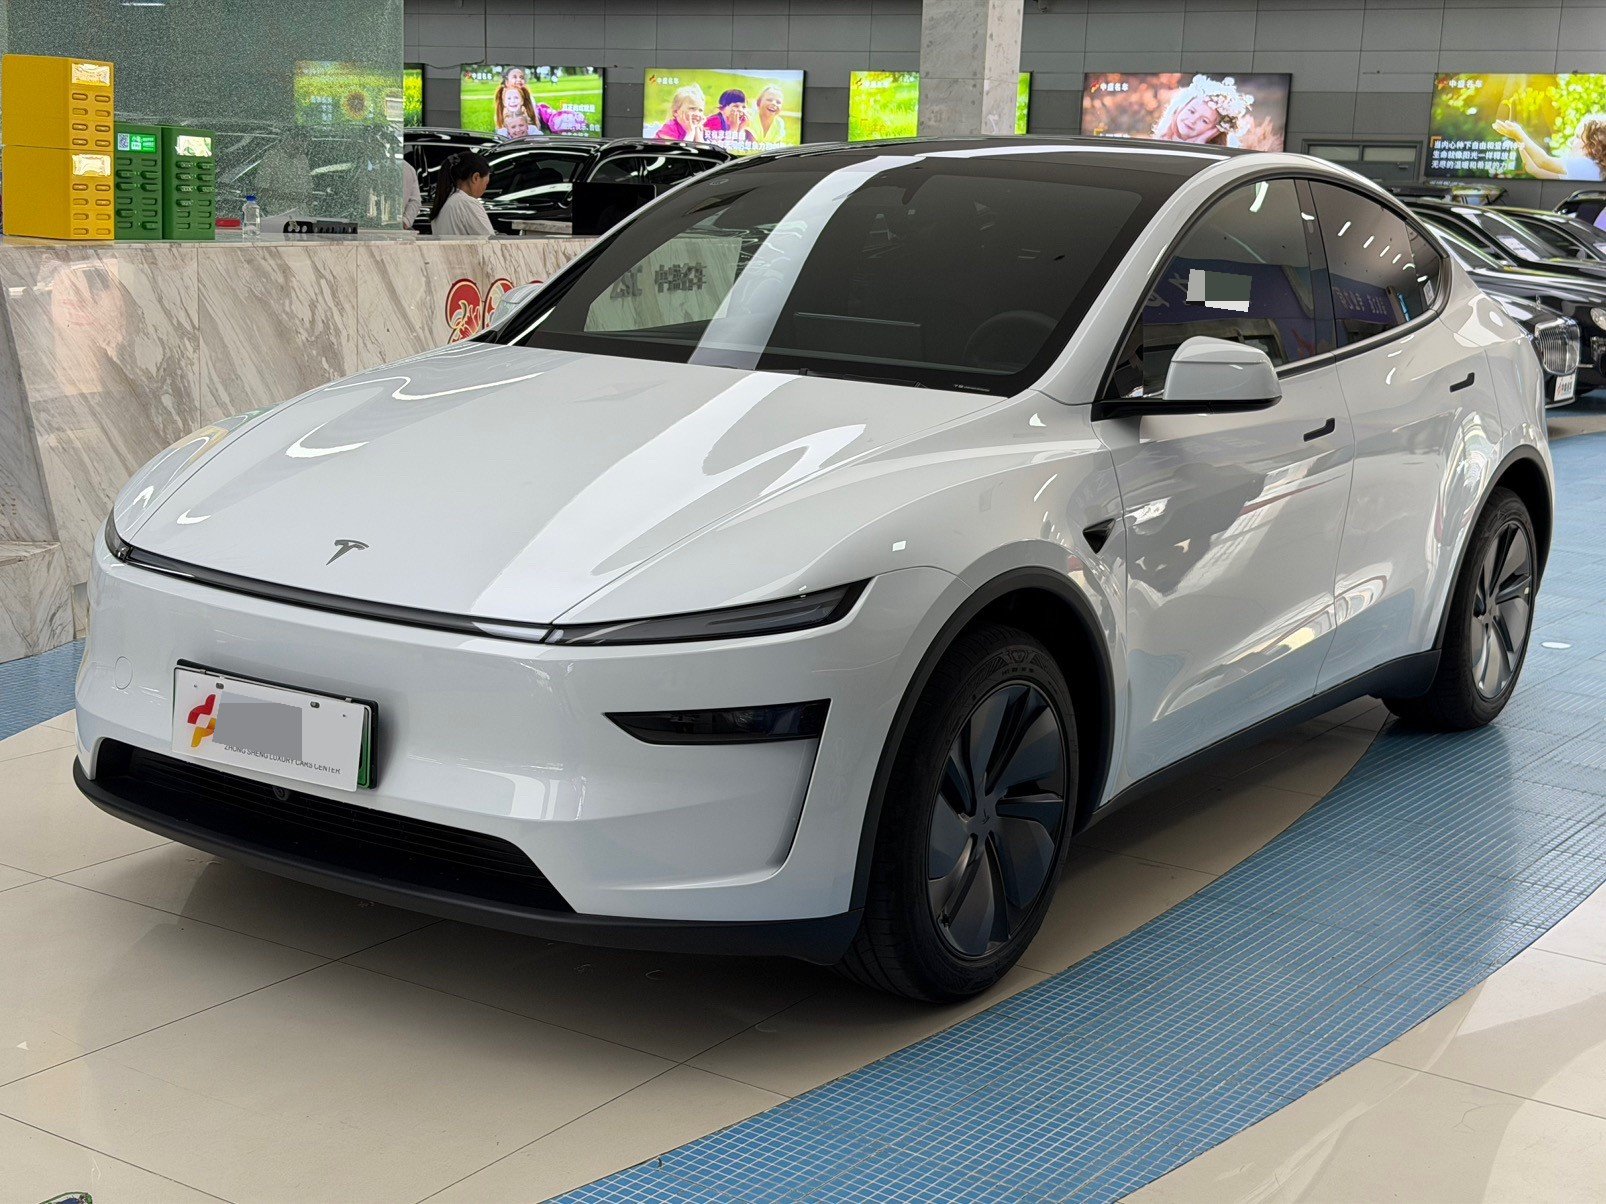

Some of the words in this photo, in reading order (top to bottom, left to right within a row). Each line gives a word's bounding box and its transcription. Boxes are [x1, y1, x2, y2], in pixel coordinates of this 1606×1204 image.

[269, 754, 294, 765] LUXURY
[295, 759, 313, 769] CARS
[314, 763, 341, 774] CENTER
